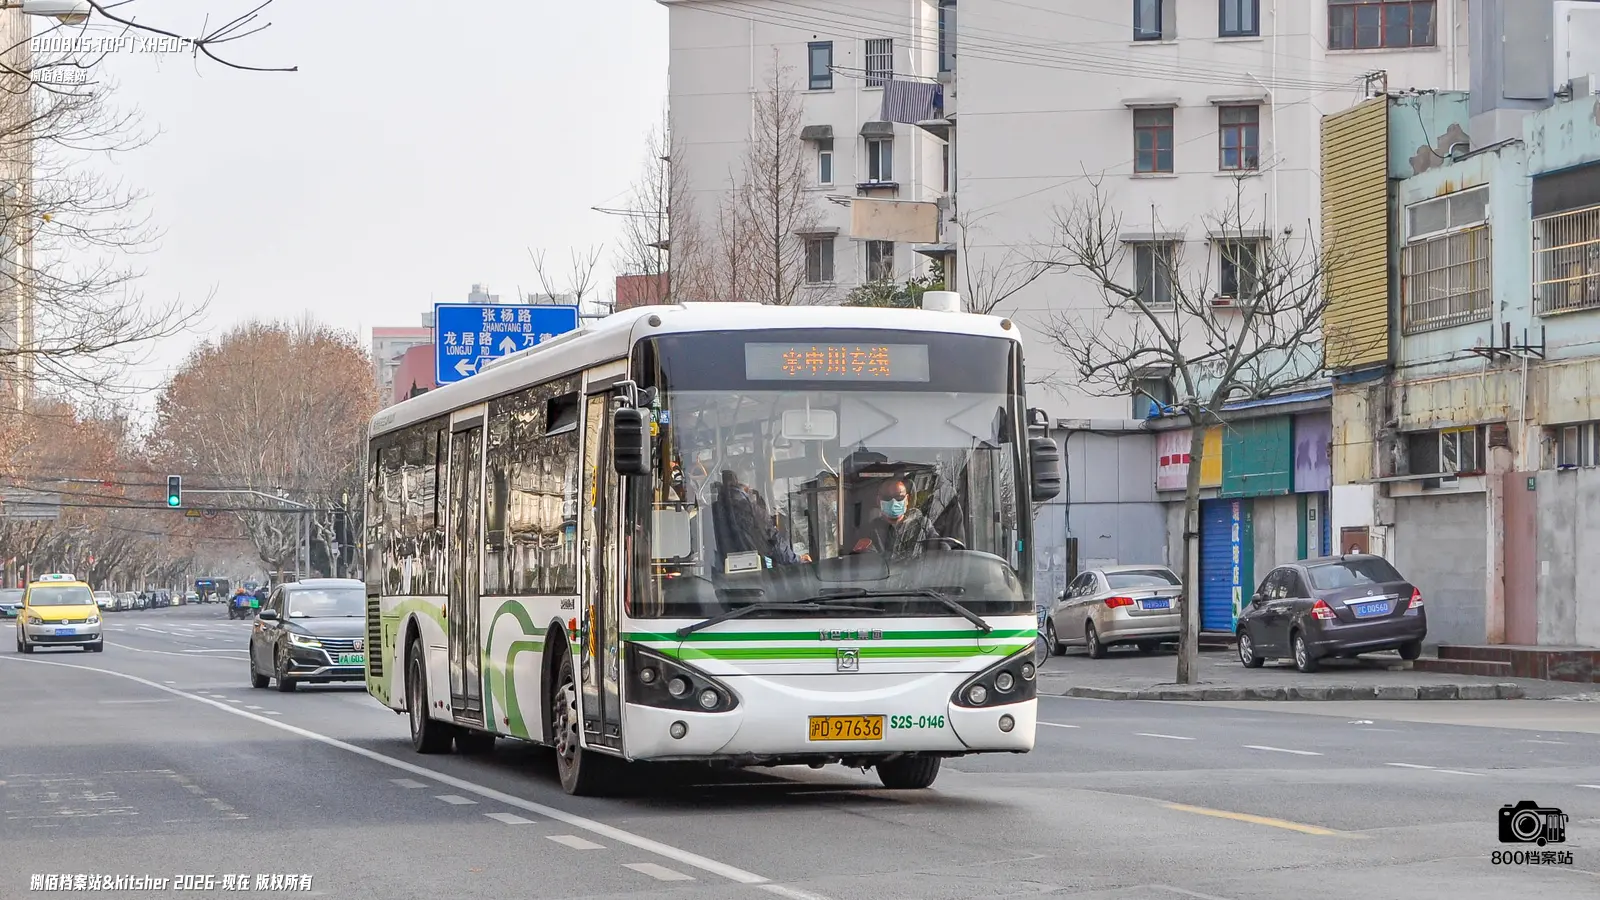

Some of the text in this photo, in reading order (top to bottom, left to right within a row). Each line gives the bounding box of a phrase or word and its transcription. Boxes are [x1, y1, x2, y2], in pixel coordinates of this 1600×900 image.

[482, 308, 532, 323] 张杨路
[482, 322, 532, 333] ZHANGYANG RD
[443, 331, 493, 346] 龙居路
[522, 332, 564, 347] 万德
[446, 346, 490, 356] LONGJU RD
[890, 715, 945, 729] S2S-0146
